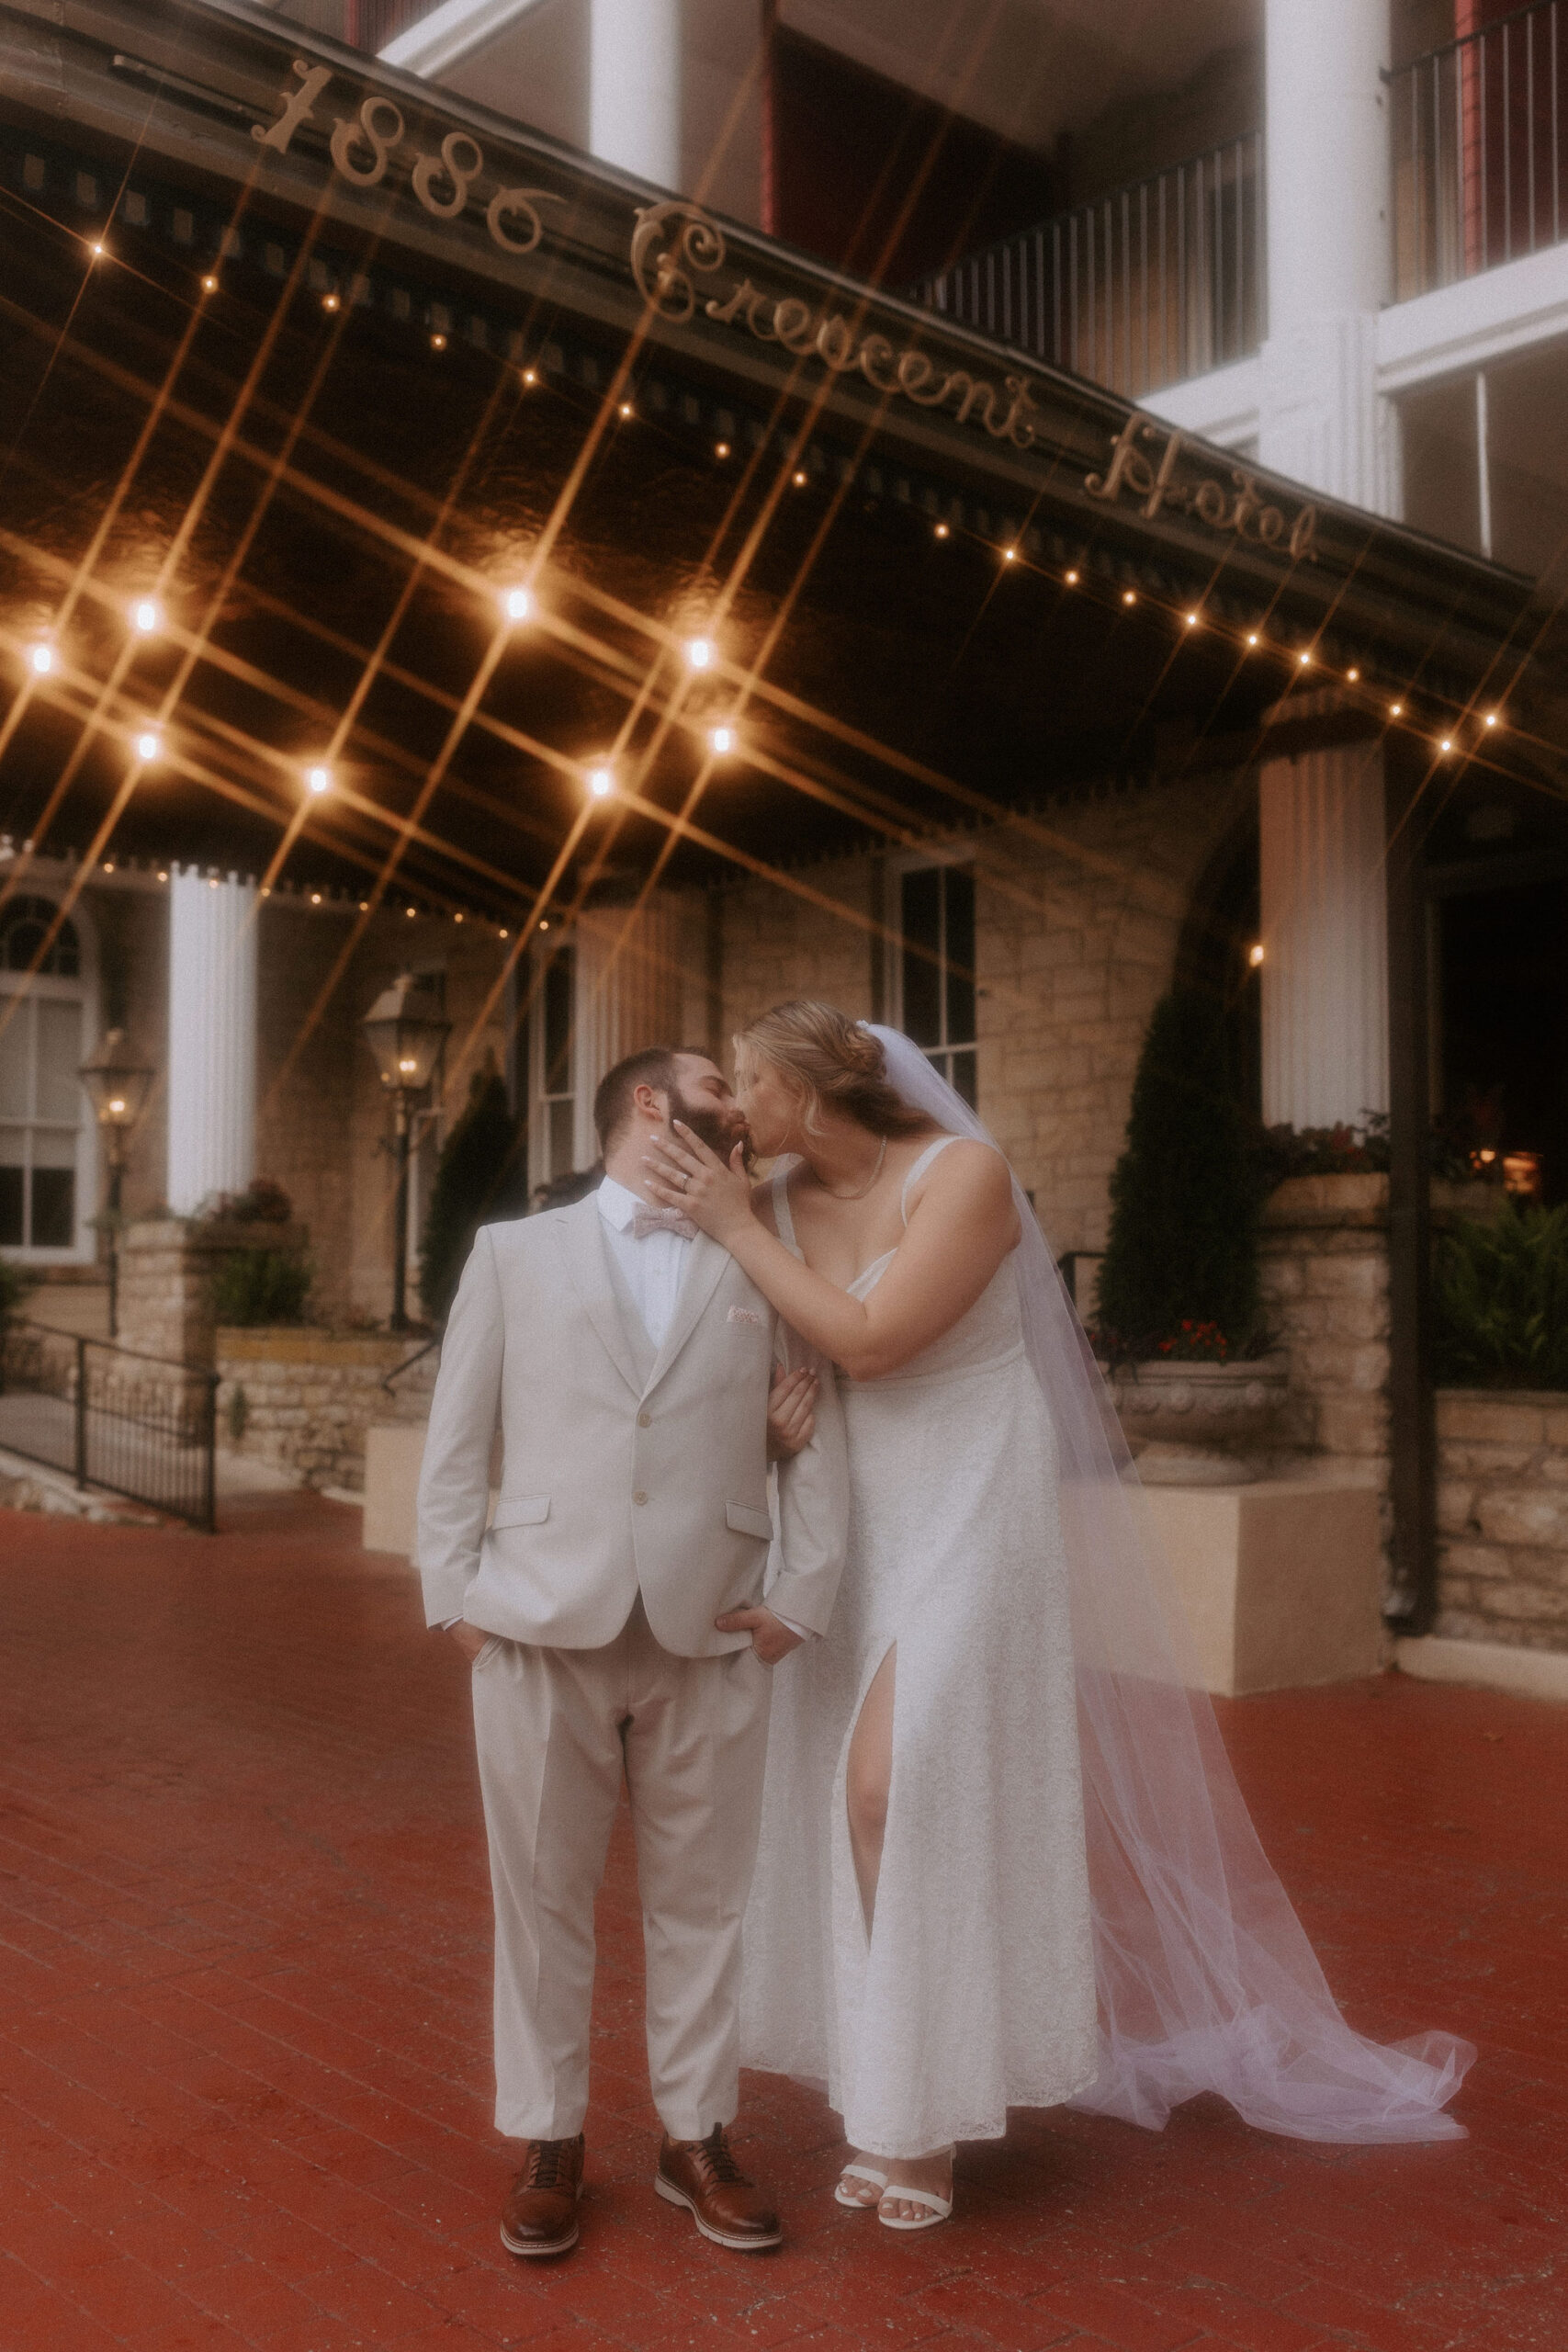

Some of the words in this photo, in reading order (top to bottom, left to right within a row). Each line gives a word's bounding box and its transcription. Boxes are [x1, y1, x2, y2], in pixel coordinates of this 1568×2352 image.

[251, 59, 568, 254] 1886
[630, 200, 1037, 448] Crescent
[1084, 411, 1319, 562] Hotel
